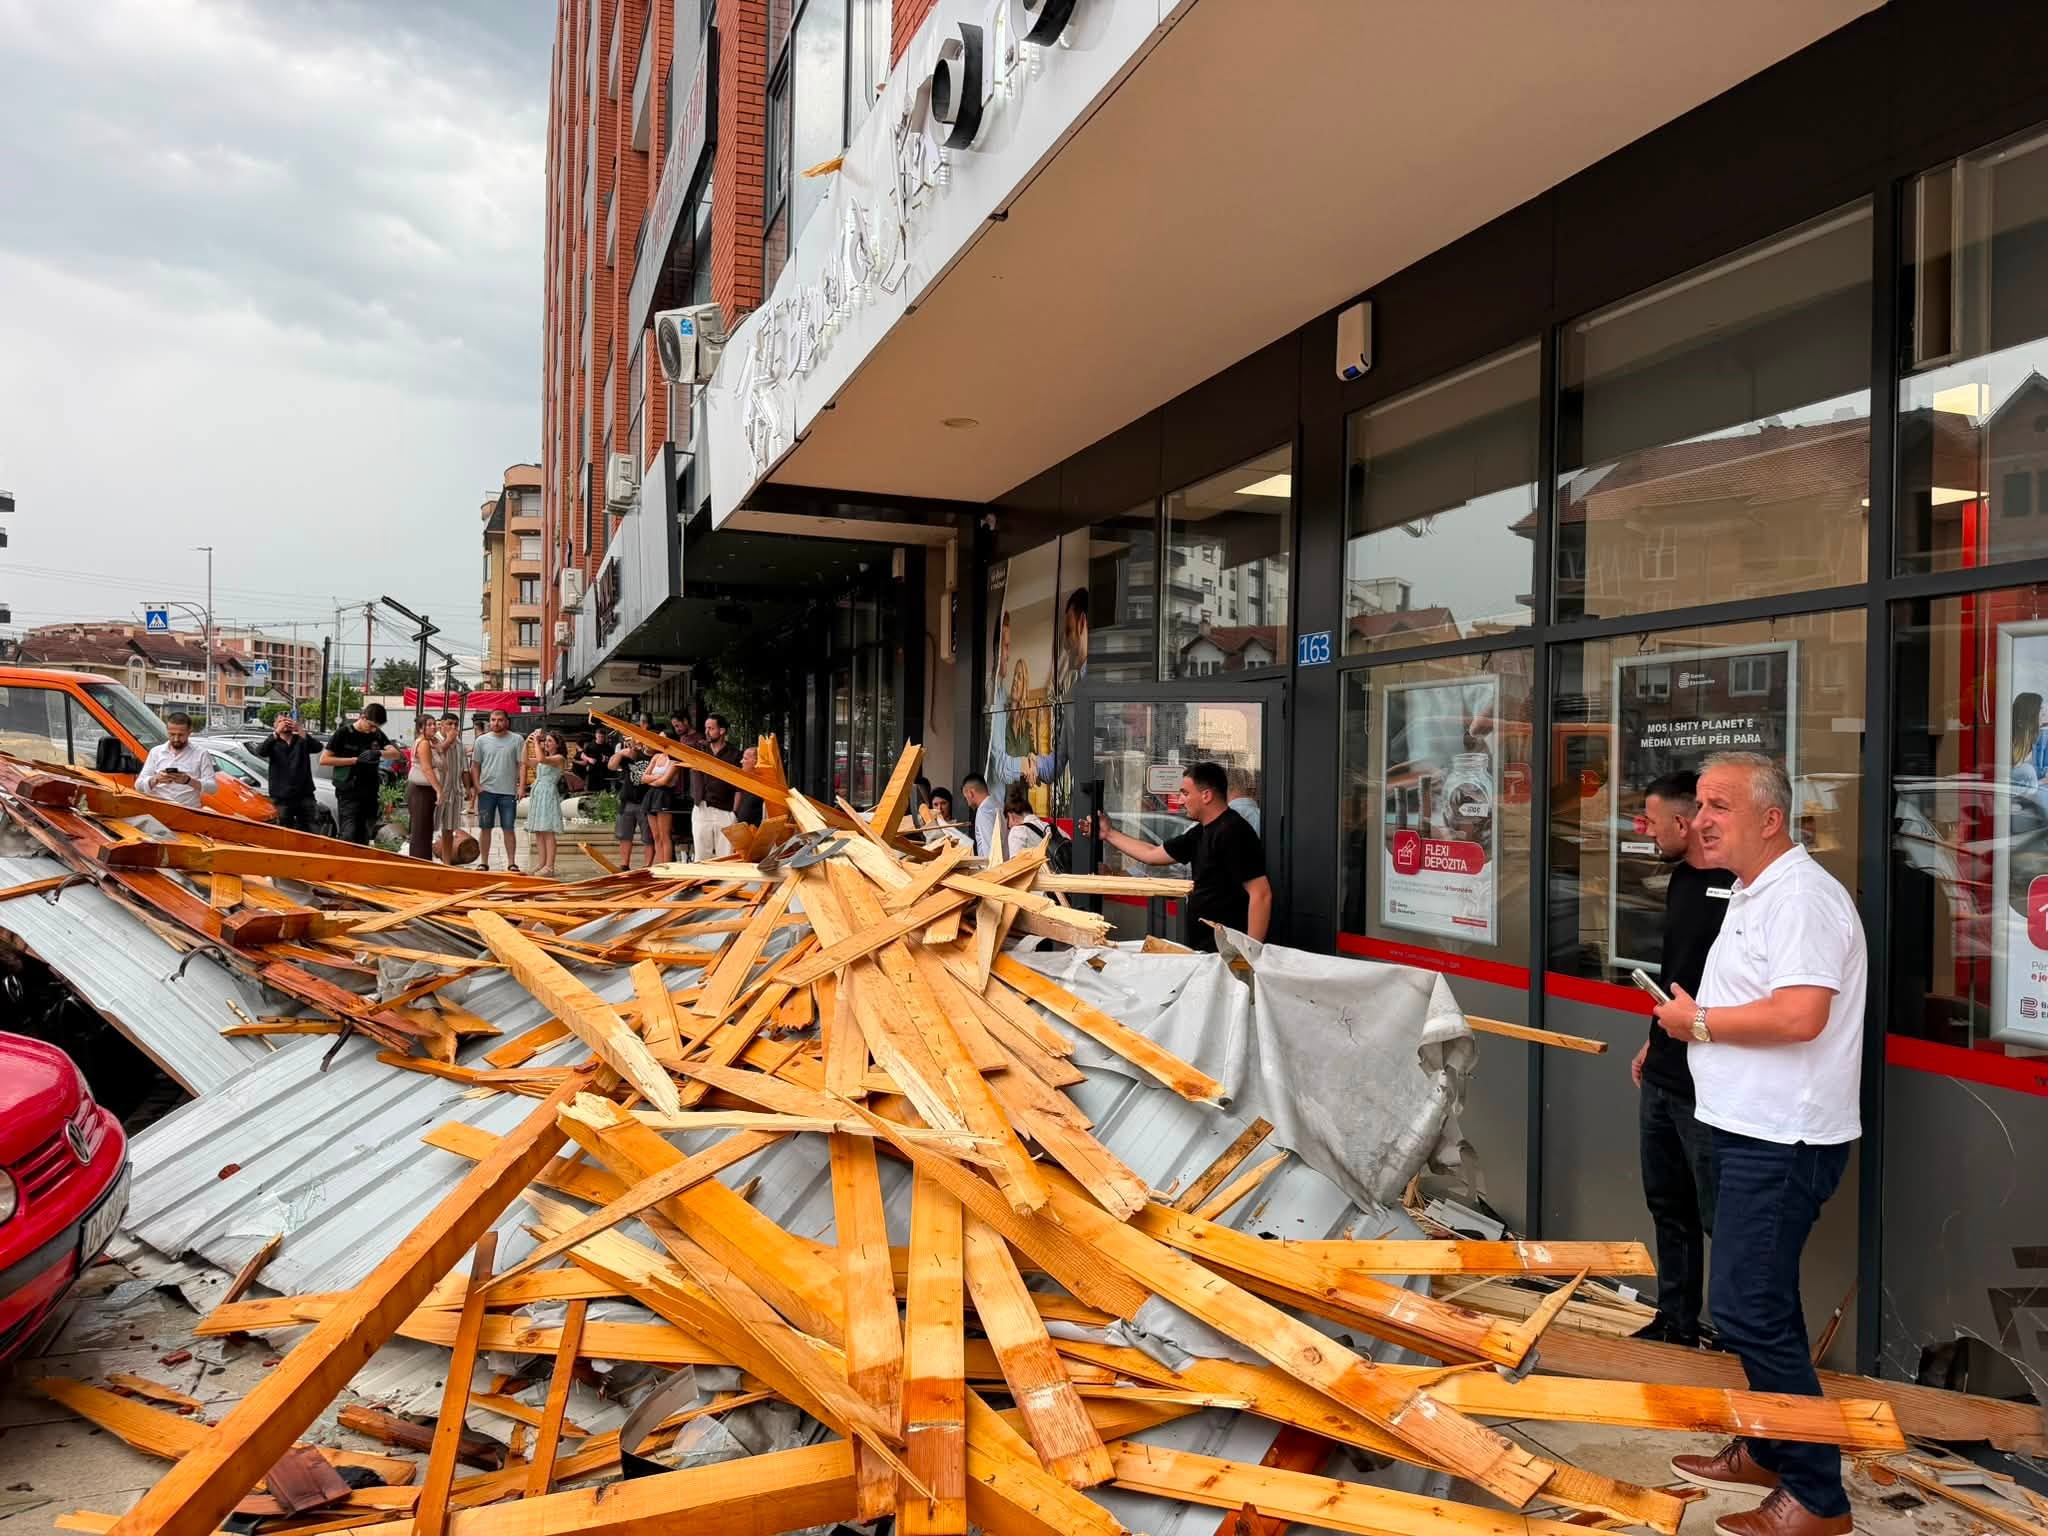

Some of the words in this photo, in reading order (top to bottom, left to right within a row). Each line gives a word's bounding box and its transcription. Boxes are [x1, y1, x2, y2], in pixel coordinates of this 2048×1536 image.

[1300, 634, 1330, 664] 163
[1647, 723, 1667, 733] MOS
[1669, 723, 1673, 732] I
[1674, 721, 1699, 732] SHTY
[1701, 718, 1745, 730] PLANET
[1747, 718, 1753, 728] E
[1640, 735, 1672, 748] MËDHA
[1674, 734, 1706, 746] VETËM
[1708, 733, 1731, 745] PËR
[1733, 733, 1761, 744] PARA
[1425, 843, 1449, 856] FLEXI
[1424, 856, 1468, 872] DEPOZITA
